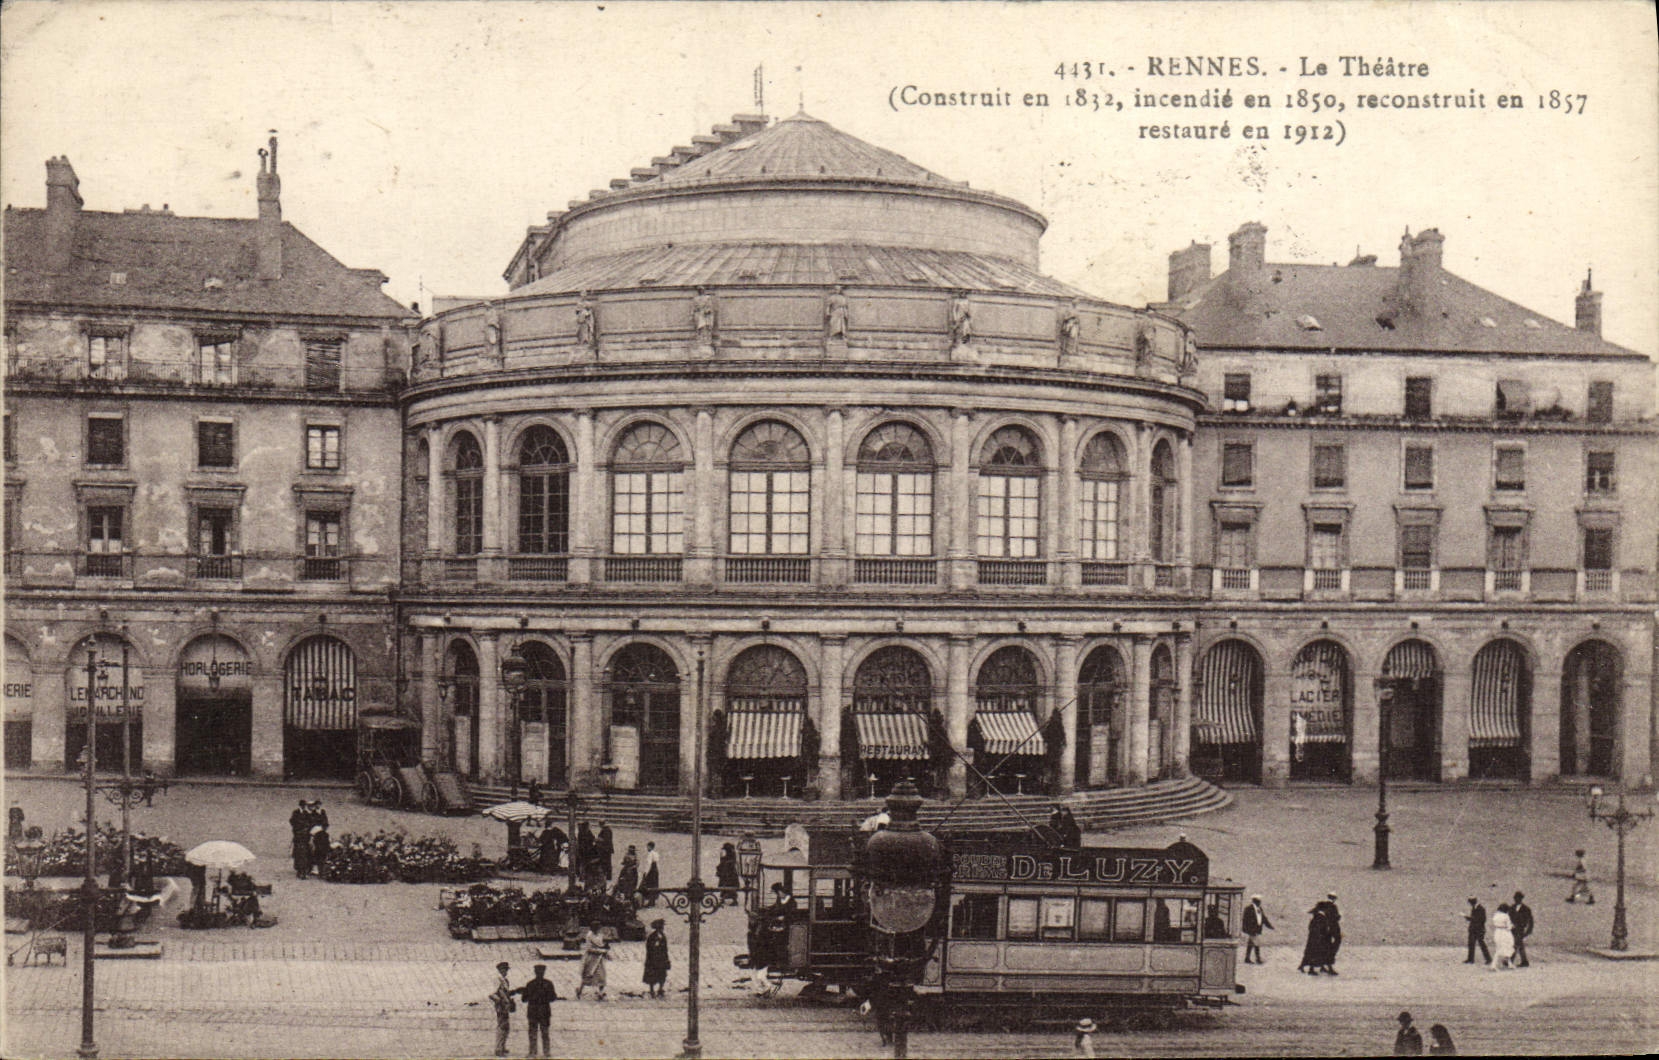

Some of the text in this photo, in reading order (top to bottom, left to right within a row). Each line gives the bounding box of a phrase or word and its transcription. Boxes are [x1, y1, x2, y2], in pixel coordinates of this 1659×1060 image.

[181, 661, 253, 676] HORLOGERIE
[70, 686, 144, 701] LEARCHND
[292, 687, 356, 701] TABAC
[1058, 856, 1198, 884] LUZY.
